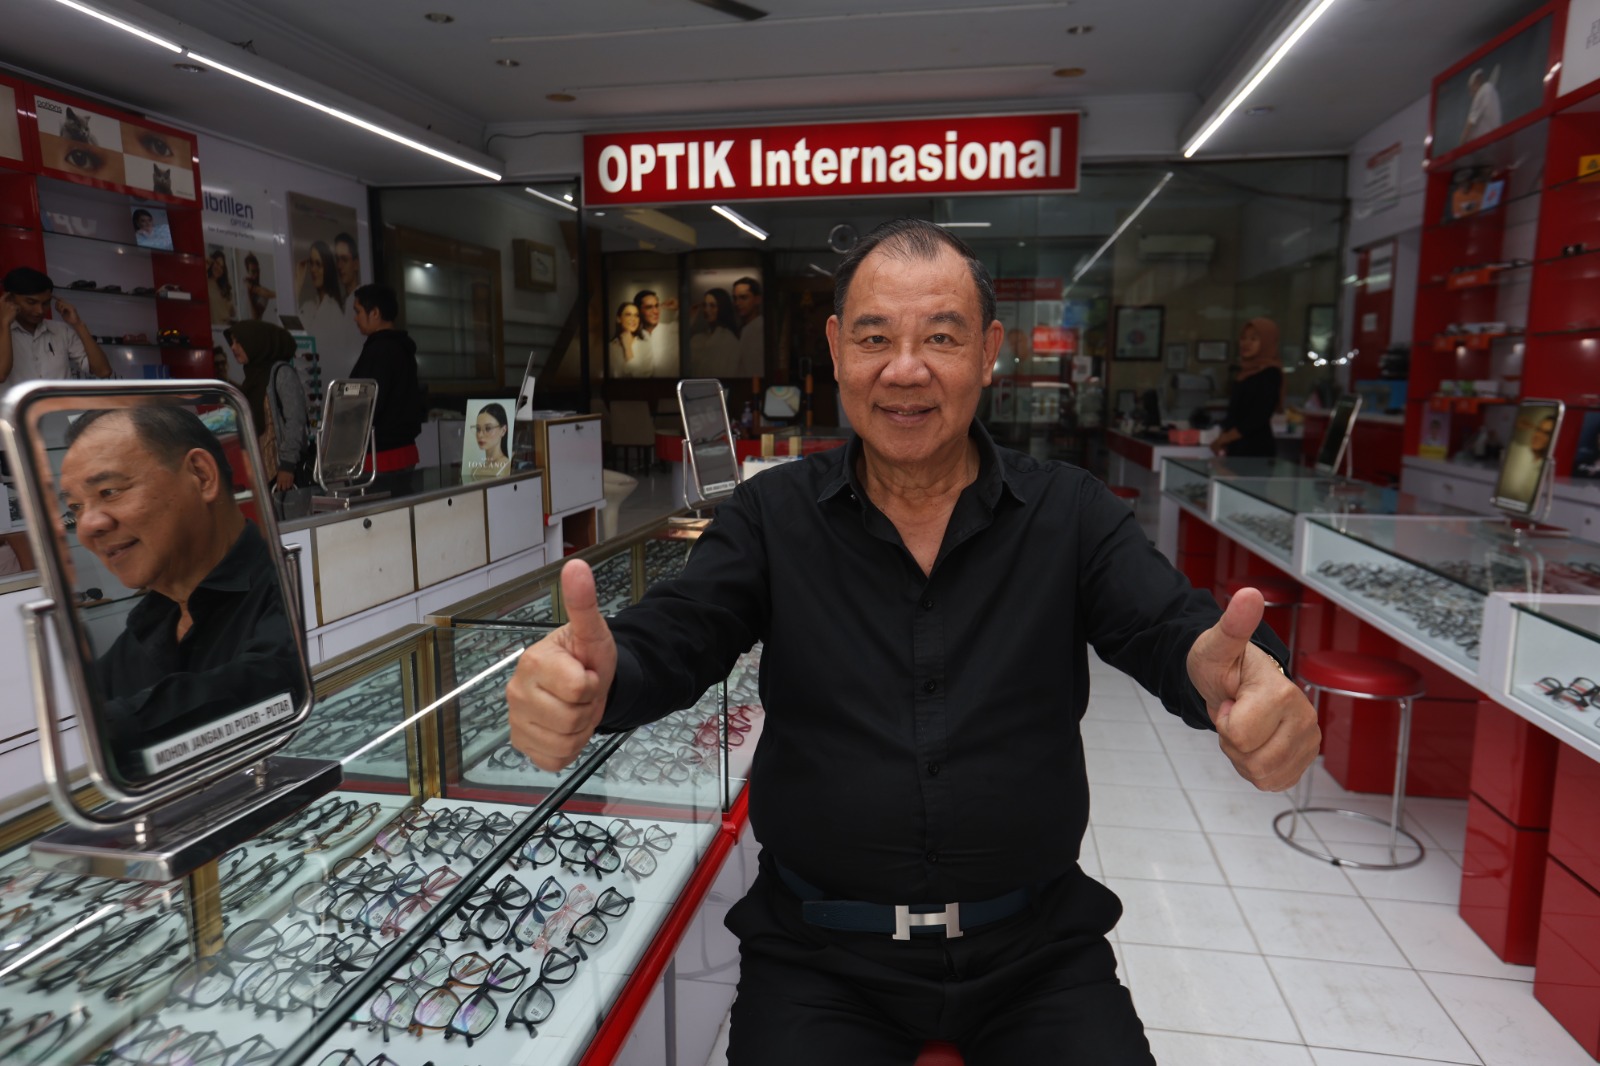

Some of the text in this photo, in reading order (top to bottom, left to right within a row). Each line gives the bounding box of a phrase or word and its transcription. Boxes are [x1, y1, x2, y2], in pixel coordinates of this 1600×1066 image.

[598, 127, 1062, 193] OPTIK Internasional
[156, 741, 189, 765] MOHON
[192, 726, 224, 751] JANGAN
[225, 722, 235, 736] DI
[235, 711, 261, 732] PUTAR
[266, 699, 290, 719] PUTAR
